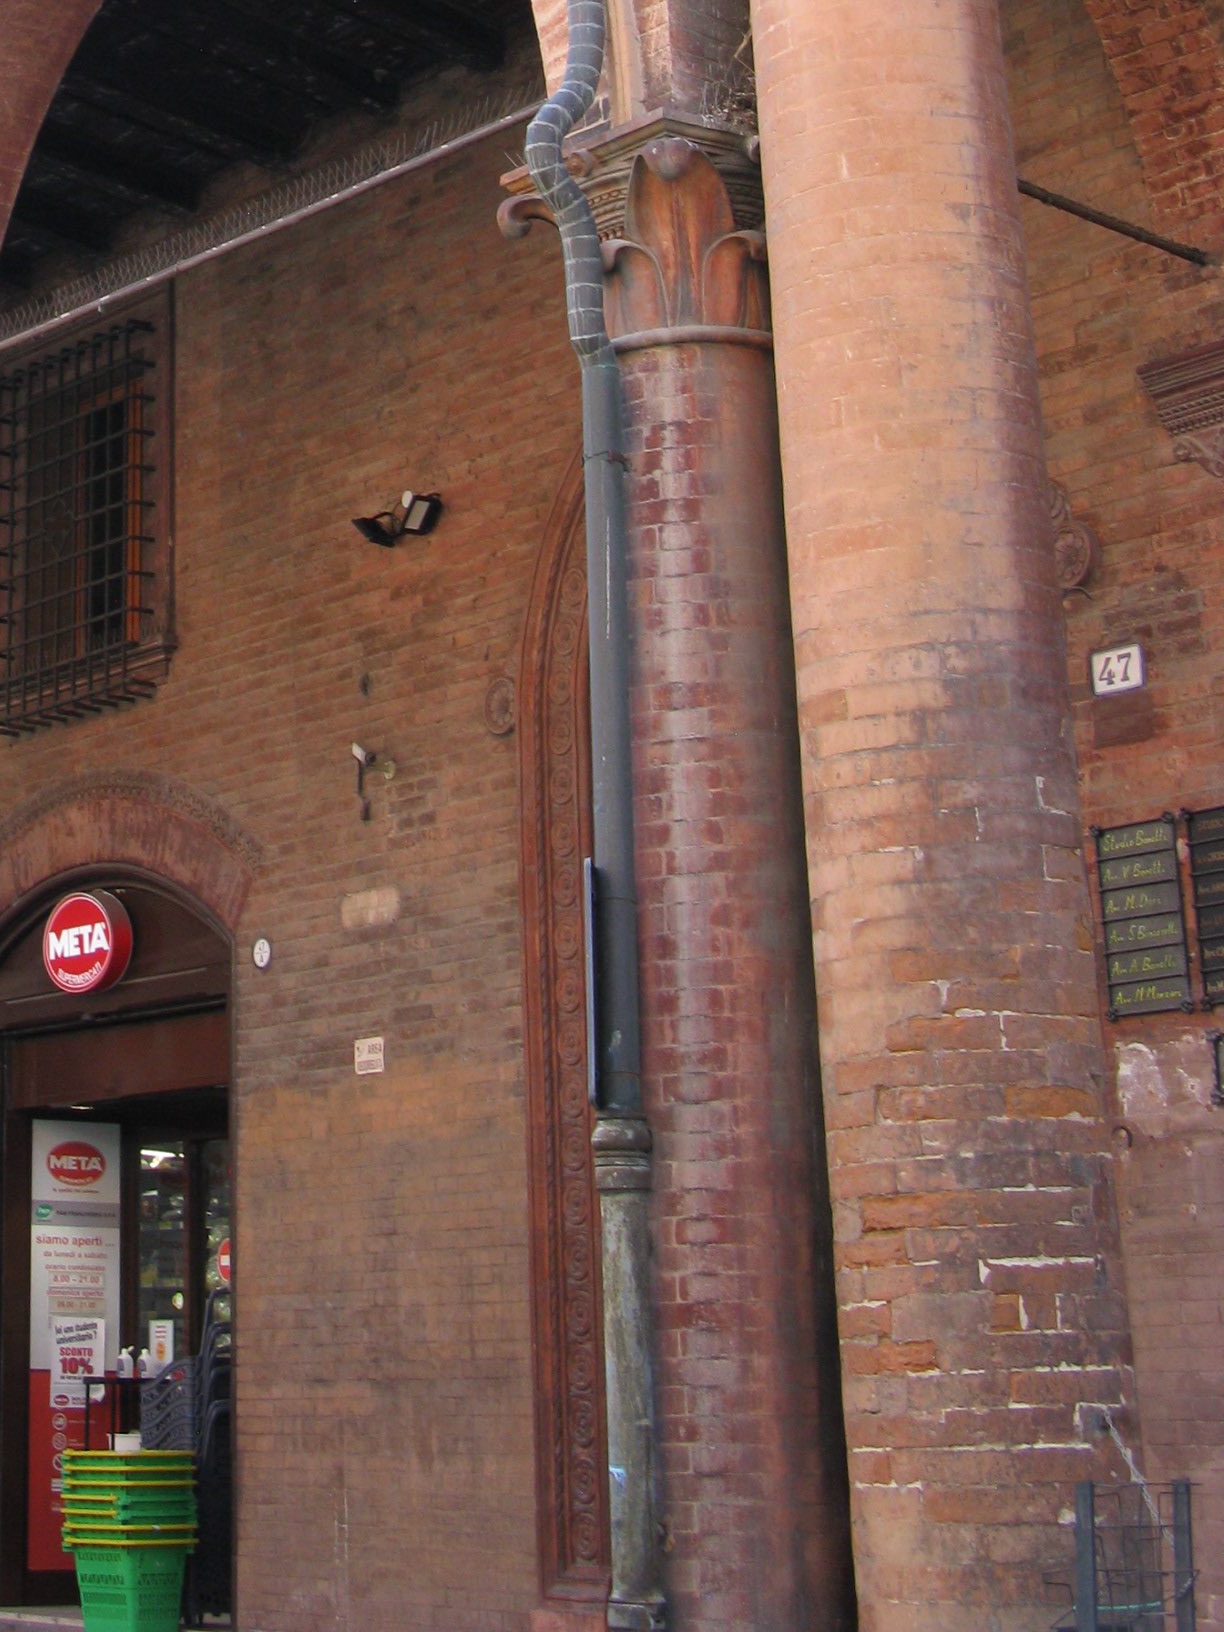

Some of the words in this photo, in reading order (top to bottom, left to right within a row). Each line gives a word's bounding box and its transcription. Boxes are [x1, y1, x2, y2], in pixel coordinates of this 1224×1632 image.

[1098, 652, 1132, 686] 47
[36, 1234, 69, 1245] siamo
[72, 1235, 104, 1248] aperti
[59, 1346, 94, 1357] SCONTO
[59, 1357, 94, 1375] 10%
